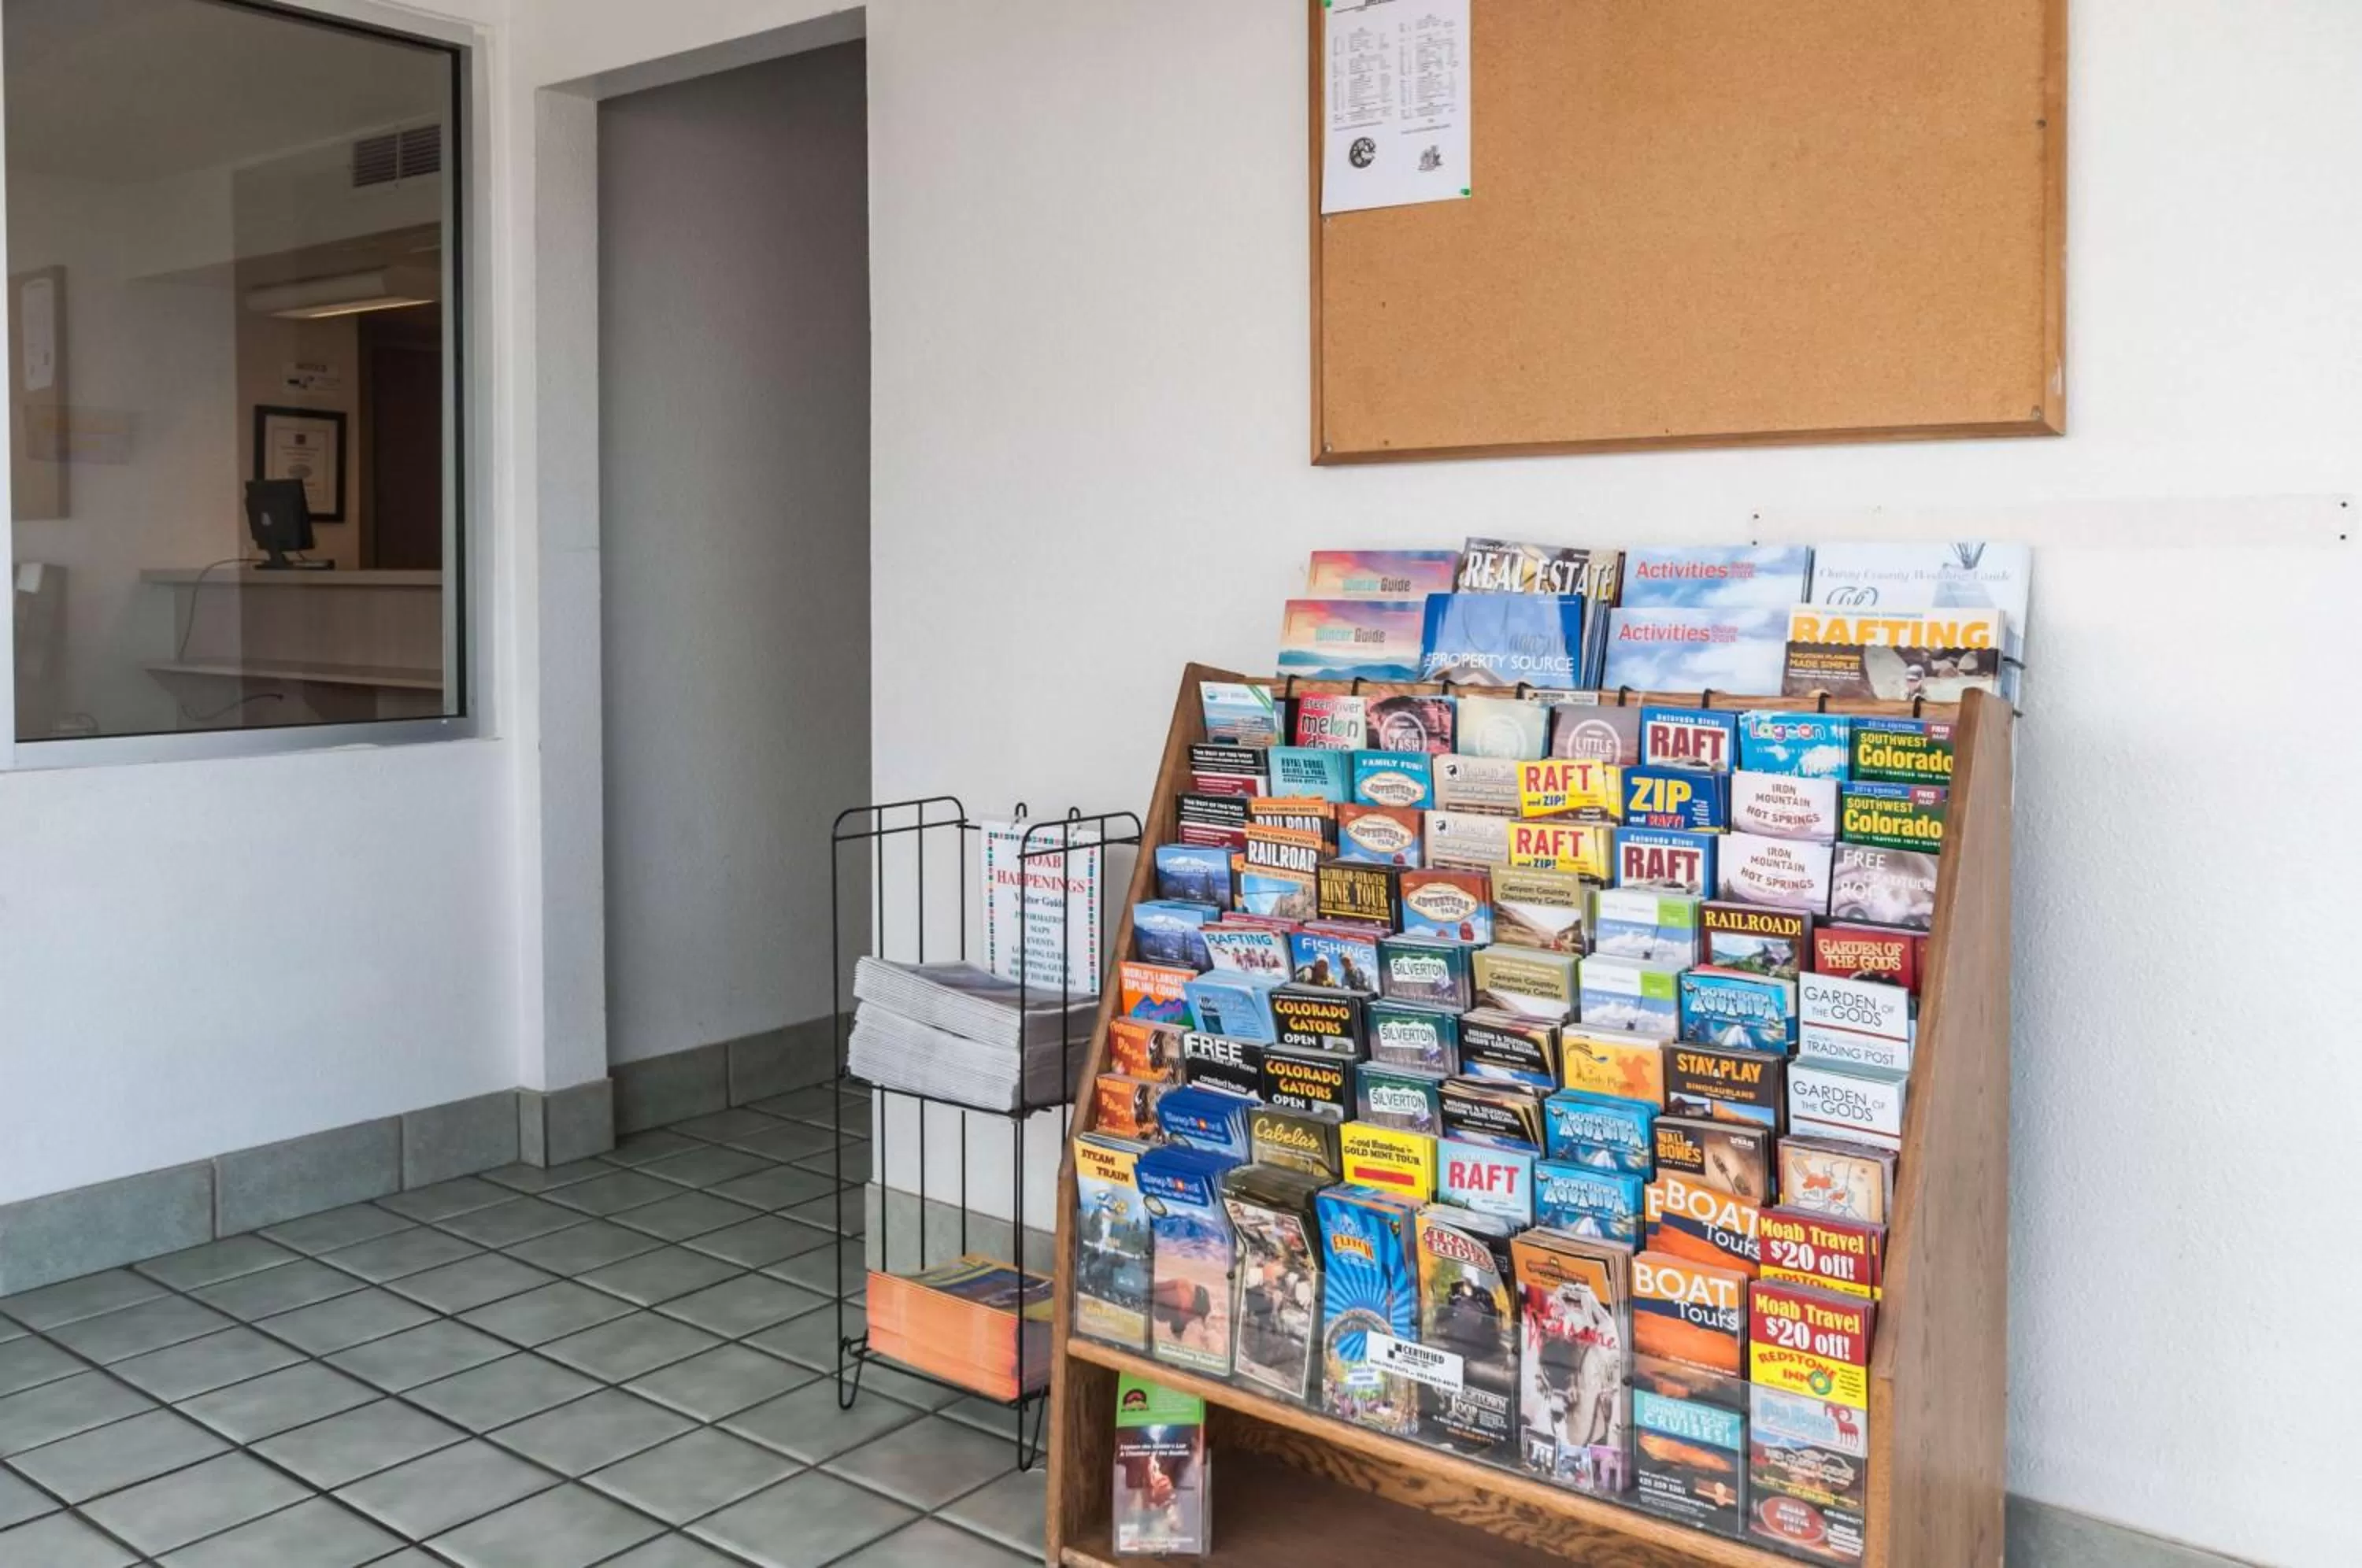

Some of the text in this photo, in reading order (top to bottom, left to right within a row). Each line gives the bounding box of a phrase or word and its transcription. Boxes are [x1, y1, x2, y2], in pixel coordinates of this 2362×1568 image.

[1465, 552, 1615, 600] REAL ESTATE
[1635, 562, 1728, 579] Activities
[1380, 578, 1411, 592] Guide
[1354, 628, 1386, 643] Guide
[1619, 624, 1710, 642] Activities
[1792, 616, 1990, 649] RAFTING
[1431, 651, 1508, 668] PROPERTY
[1512, 655, 1575, 671] SOURCE
[1790, 660, 1818, 669] MADE
[1301, 714, 1358, 738] melon
[1749, 720, 1825, 743] Lagoon
[1931, 725, 1949, 734] FREE
[1388, 739, 1420, 752] WASH
[1576, 738, 1612, 753] LITTLE
[1650, 725, 1726, 762] RAFT
[1860, 733, 1927, 748] SOUTHWEST
[1362, 759, 1423, 771] FAMILY FUN!
[1858, 745, 1953, 772] Colorado
[1526, 764, 1592, 793] RAFT
[1772, 784, 1796, 794] IRON
[1543, 795, 1565, 807] ZIP!
[1629, 777, 1692, 813] ZIP
[1756, 793, 1810, 808] MOUNTAIN
[1847, 798, 1913, 813] SOUTHWEST
[1746, 805, 1820, 825] HOT SPRINGS
[1844, 809, 1942, 839] Colorado
[1516, 828, 1584, 857] RAFT
[1768, 847, 1791, 859] IRON
[1248, 840, 1316, 873] RAILROAD
[1533, 859, 1557, 869] ZIP!
[1624, 846, 1700, 882] RAFT
[1750, 856, 1805, 872] MOUNTAIN
[1842, 851, 1887, 870] FREE
[1741, 867, 1814, 889] HOT SPRINGS
[1320, 879, 1388, 907] MINE TOUR
[1501, 883, 1571, 897] Canyon Country
[1545, 896, 1574, 906] Center
[1705, 911, 1801, 935] RAILROAD!
[1206, 934, 1272, 945] RAFTING
[1301, 937, 1372, 961] FISHING
[1818, 938, 1904, 957] GARDEN OF
[1393, 960, 1446, 976] SILVERTON
[1825, 955, 1901, 971] THE GODS
[1525, 977, 1560, 989] Country
[1534, 988, 1562, 999] Center
[1275, 1000, 1349, 1019] COLORADO
[1690, 989, 1779, 1021] AQUARIUM
[1804, 986, 1895, 1013] GARDEN OF
[1289, 1016, 1342, 1035] GATORS
[1812, 1005, 1883, 1027] THE GODS
[1283, 1033, 1316, 1046] OPEN
[1381, 1026, 1435, 1042] SILVERTON
[1185, 1034, 1242, 1064] FREE
[1806, 1041, 1894, 1066] TRADING POST
[1265, 1060, 1342, 1085] COLORADO
[1677, 1053, 1761, 1083] STAY PLAY
[1279, 1078, 1332, 1100] GATORS
[1372, 1090, 1426, 1109] SILVERTON
[1686, 1082, 1755, 1099] DINOSAURLAND
[1793, 1081, 1886, 1109] GARDEN OF
[1272, 1094, 1305, 1109] OPEN
[1801, 1100, 1873, 1122] THE GODS
[1253, 1118, 1319, 1149] Cabela's
[1559, 1115, 1642, 1148] AQUARIUM
[1081, 1149, 1116, 1166] STEAM
[1344, 1146, 1420, 1165] GOLD MINE TOUR
[1657, 1145, 1701, 1163] BONES
[1096, 1167, 1129, 1182] TRAIN
[1448, 1162, 1519, 1193] RAFT
[1543, 1186, 1626, 1215] AQUARIUM
[1666, 1178, 1760, 1241] BOAT
[1702, 1222, 1761, 1260] Tours
[1760, 1218, 1864, 1255] Moab Travel
[1770, 1241, 1854, 1281] $20 off!
[1632, 1262, 1734, 1311] BOAT
[1674, 1300, 1738, 1331] Tours
[1755, 1293, 1860, 1335] Moab Travel
[1765, 1316, 1850, 1361] $20 off!
[1403, 1344, 1446, 1364] CERTIFIED
[1757, 1352, 1838, 1378] REDSTONE
[1643, 1412, 1730, 1445] CRUISES!
